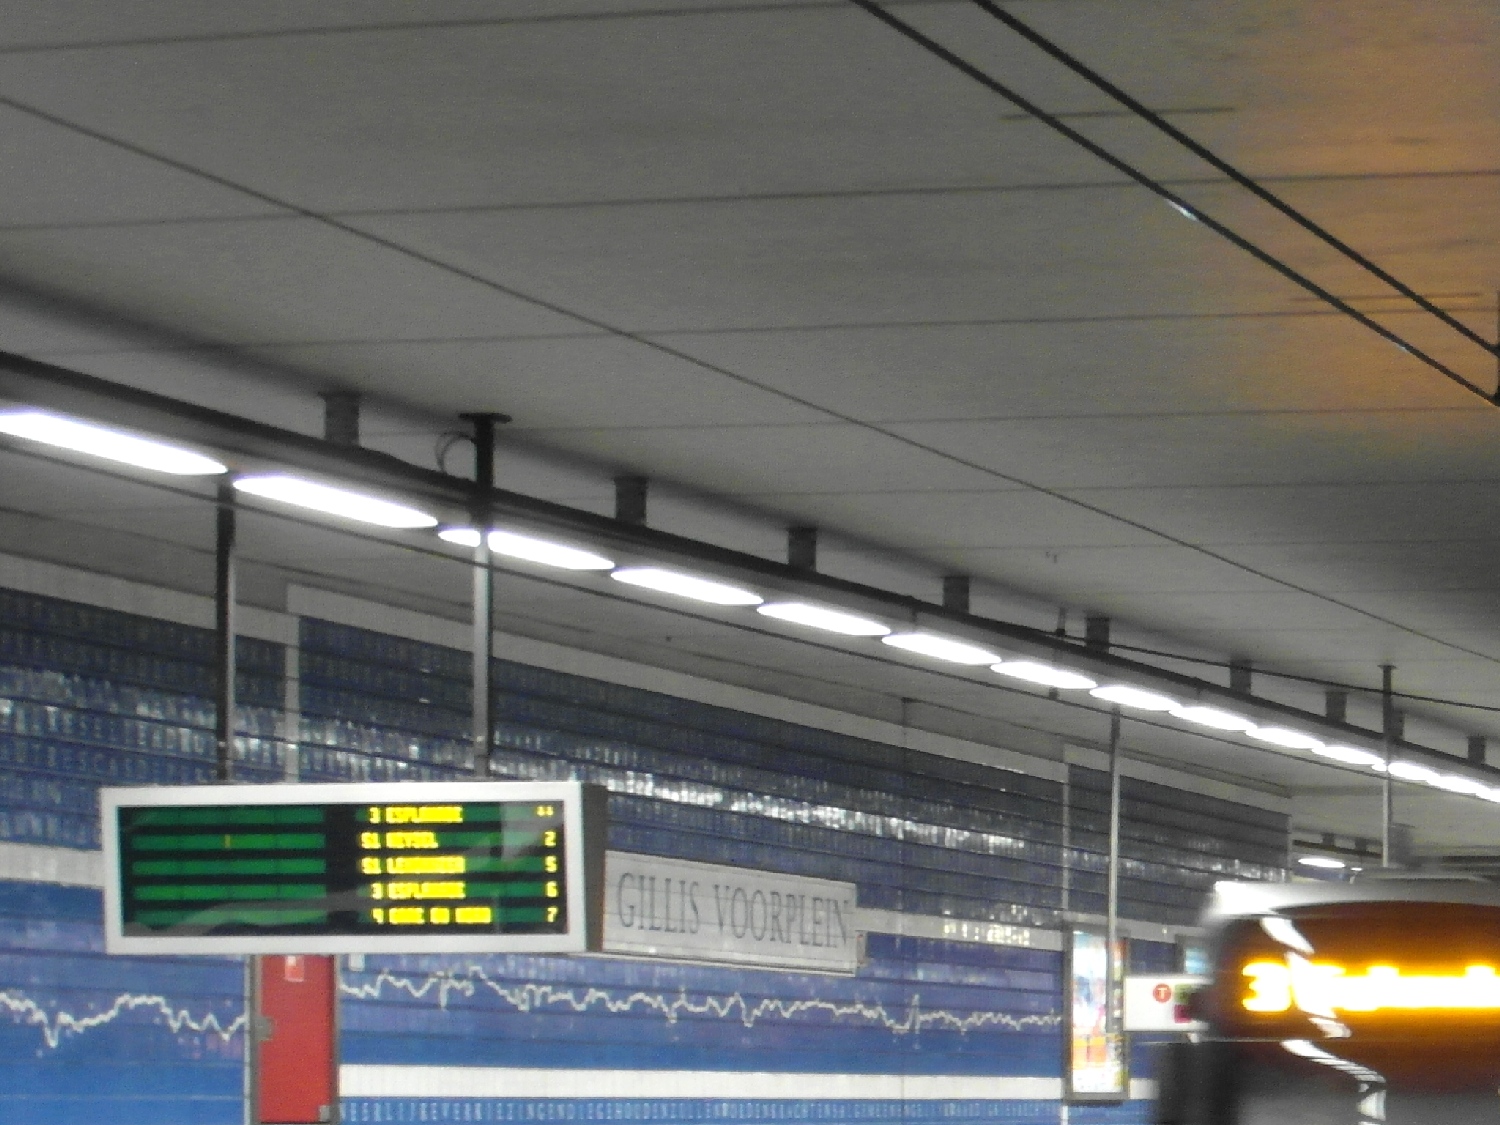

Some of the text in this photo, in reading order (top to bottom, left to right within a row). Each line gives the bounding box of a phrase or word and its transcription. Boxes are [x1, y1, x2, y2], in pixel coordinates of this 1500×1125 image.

[543, 830, 557, 847] 2
[545, 855, 557, 872] 5
[546, 907, 558, 923] 7
[616, 872, 850, 949] GILLIS VOORPLEIN
